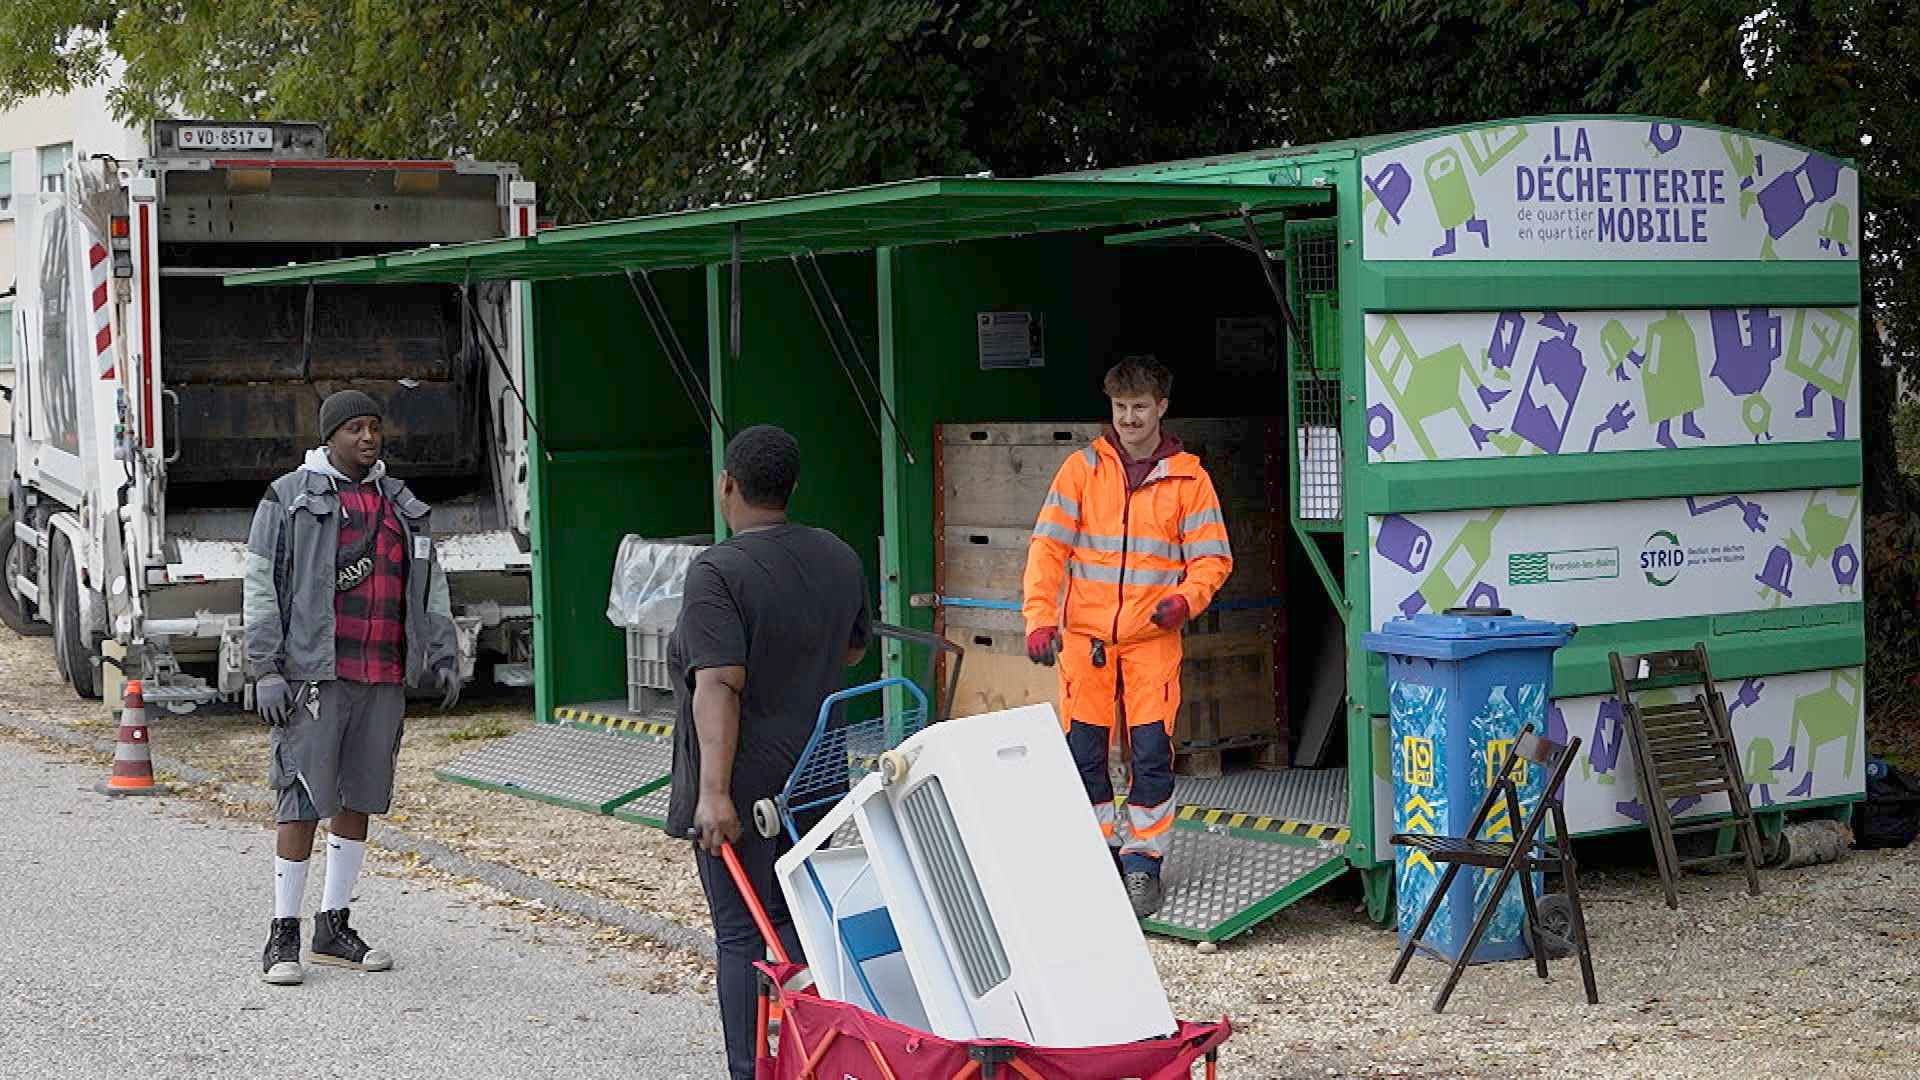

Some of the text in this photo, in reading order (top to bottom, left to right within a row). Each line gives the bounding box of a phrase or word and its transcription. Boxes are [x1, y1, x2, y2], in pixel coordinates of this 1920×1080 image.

[1553, 126, 1592, 163] LA
[1516, 154, 1725, 204] DÉCHETTERIE
[1517, 207, 1594, 224] de quartier
[1598, 207, 1708, 243] MOBILE
[1518, 226, 1594, 243] en quartier
[1640, 549, 1685, 569] STRID
